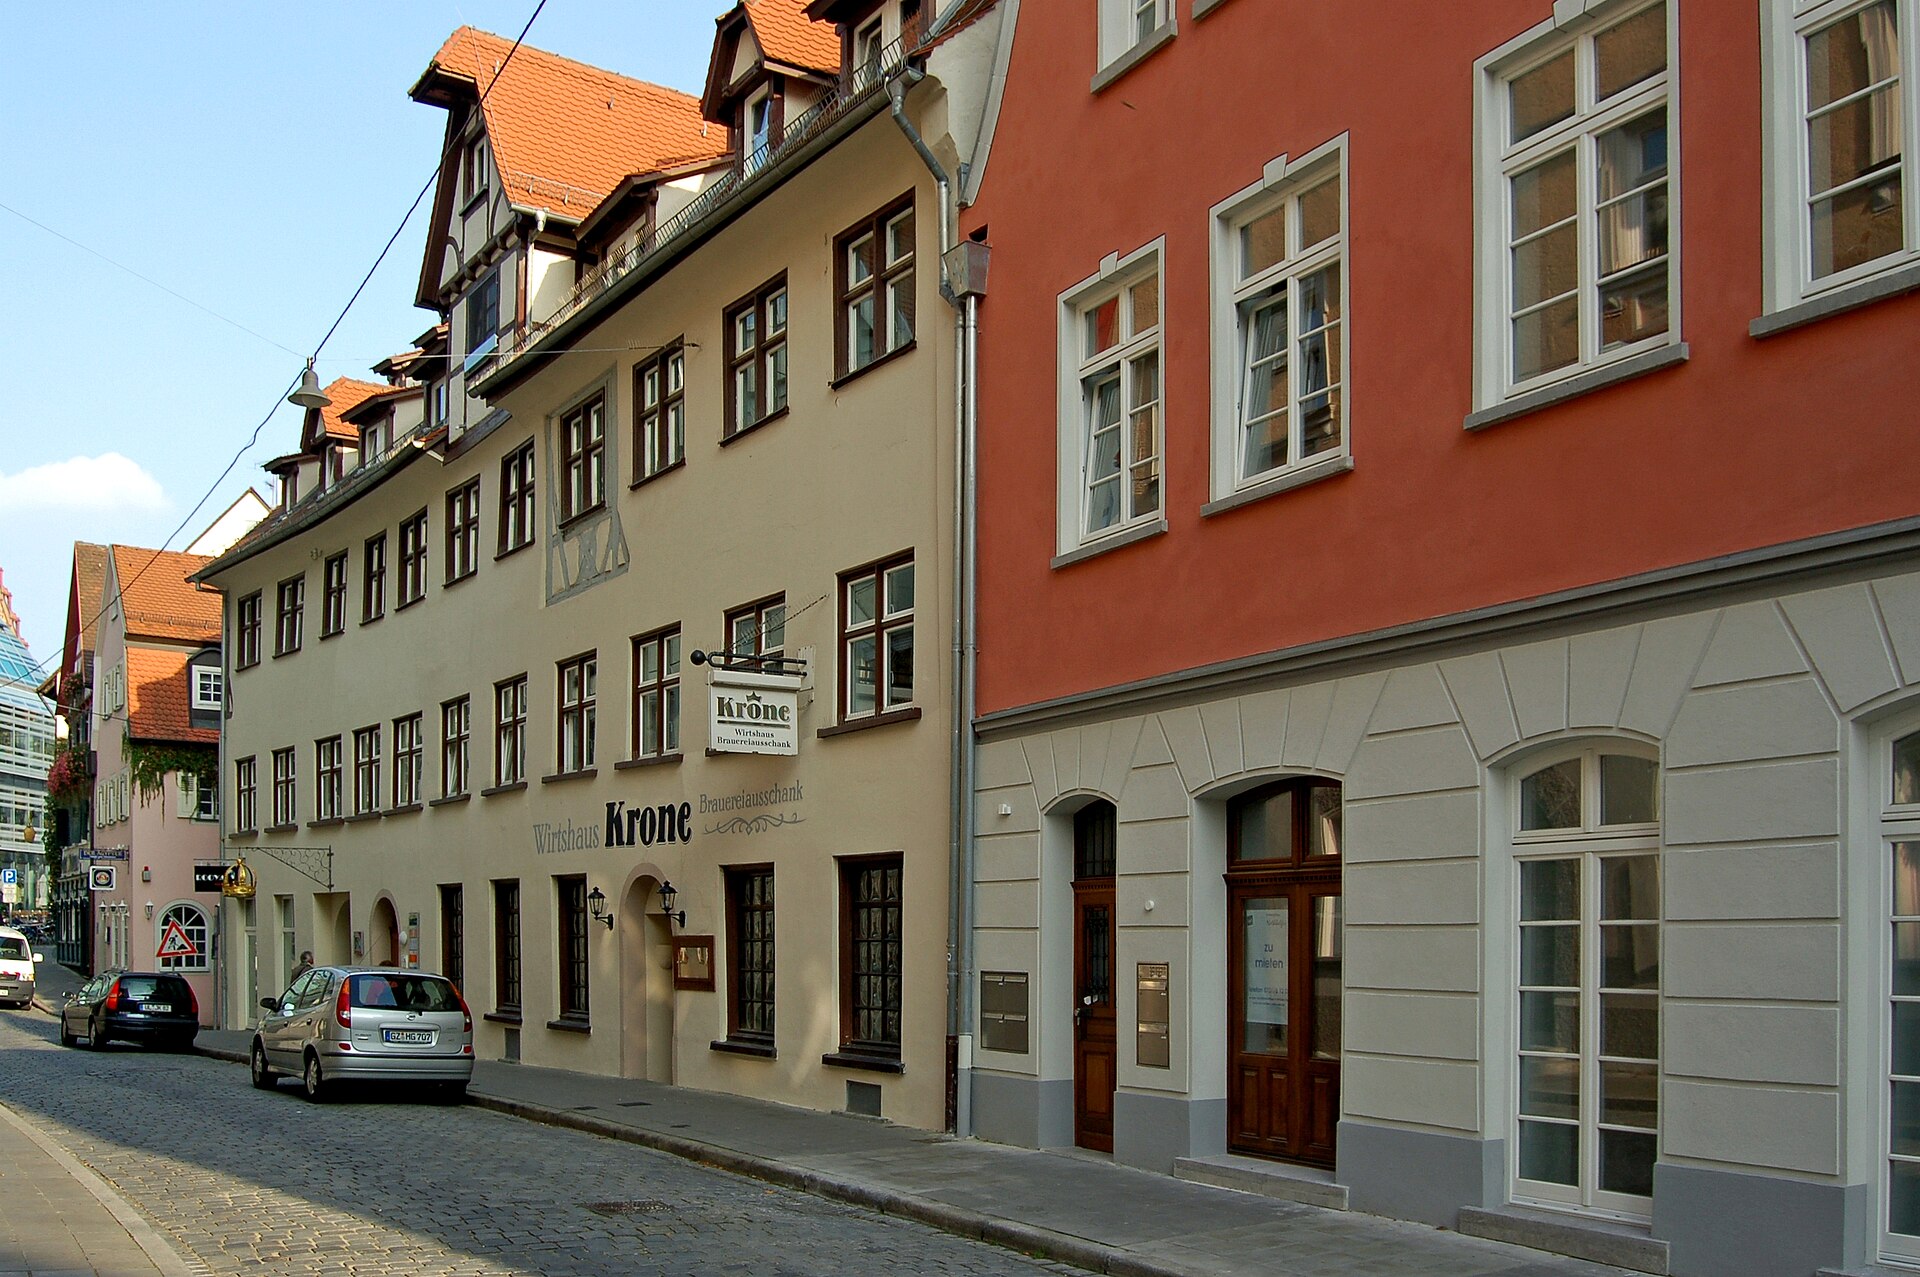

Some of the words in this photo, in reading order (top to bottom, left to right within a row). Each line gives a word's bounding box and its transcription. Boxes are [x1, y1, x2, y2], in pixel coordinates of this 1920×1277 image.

[716, 696, 791, 722] Krone
[734, 728, 775, 739] Wirtshaus
[717, 736, 792, 749] Brauereiausschank
[532, 818, 600, 855] Wirtshaus
[604, 800, 693, 849] Krone
[699, 779, 804, 814] Brauereiausschank
[6, 871, 14, 883] P
[1264, 944, 1273, 952] zu
[1255, 959, 1284, 969] mieten
[391, 1032, 400, 1040] GZ
[405, 1033, 416, 1041] HG
[417, 1033, 431, 1041] 707
